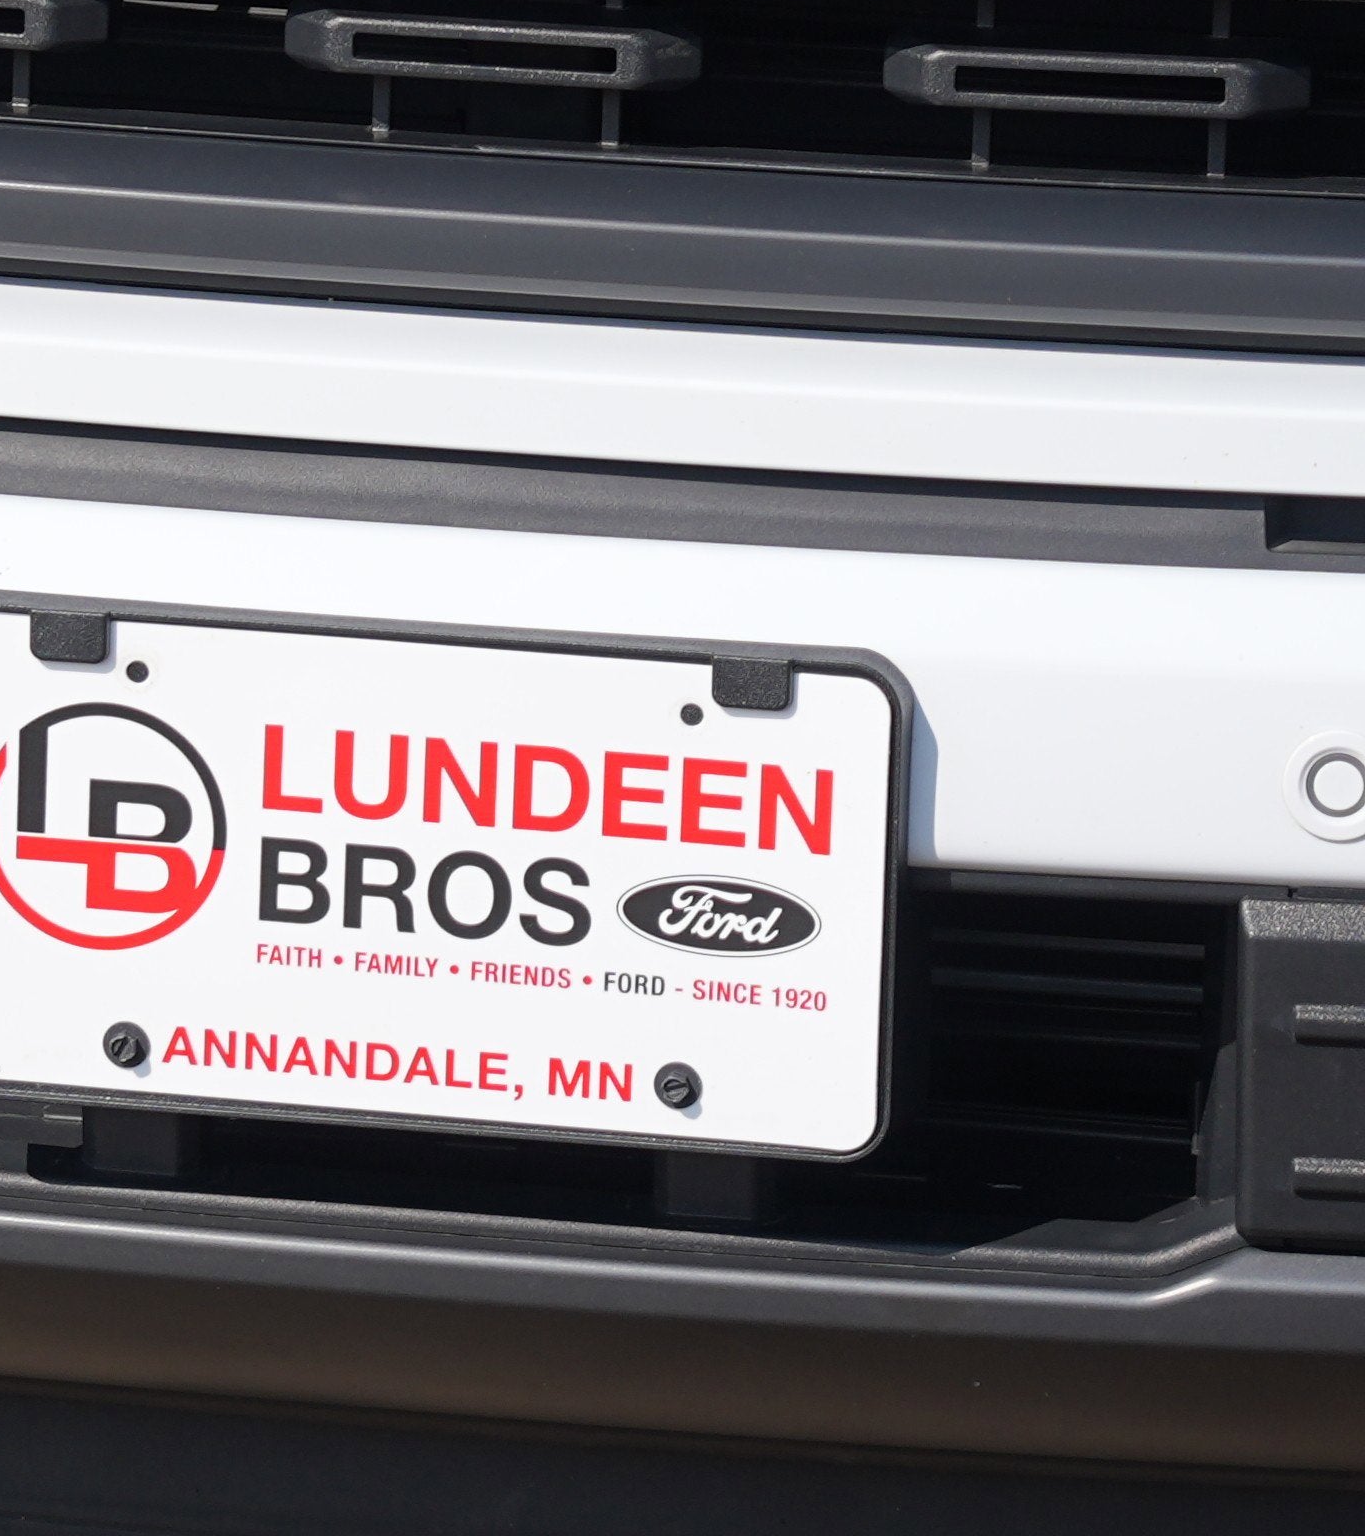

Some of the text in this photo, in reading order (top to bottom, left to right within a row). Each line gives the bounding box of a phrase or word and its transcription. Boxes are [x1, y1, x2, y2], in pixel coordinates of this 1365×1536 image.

[262, 724, 834, 856] LUNDEEN
[258, 836, 592, 947] BROS
[658, 884, 783, 944] Ford
[256, 943, 323, 968] FAITH
[354, 952, 439, 979] FAMILY
[470, 961, 572, 989] FRIENDS
[603, 972, 666, 997] FORD
[692, 979, 762, 1006] SINCE
[772, 988, 828, 1012] 1920
[161, 1026, 634, 1103] ANNANDALE, MN
